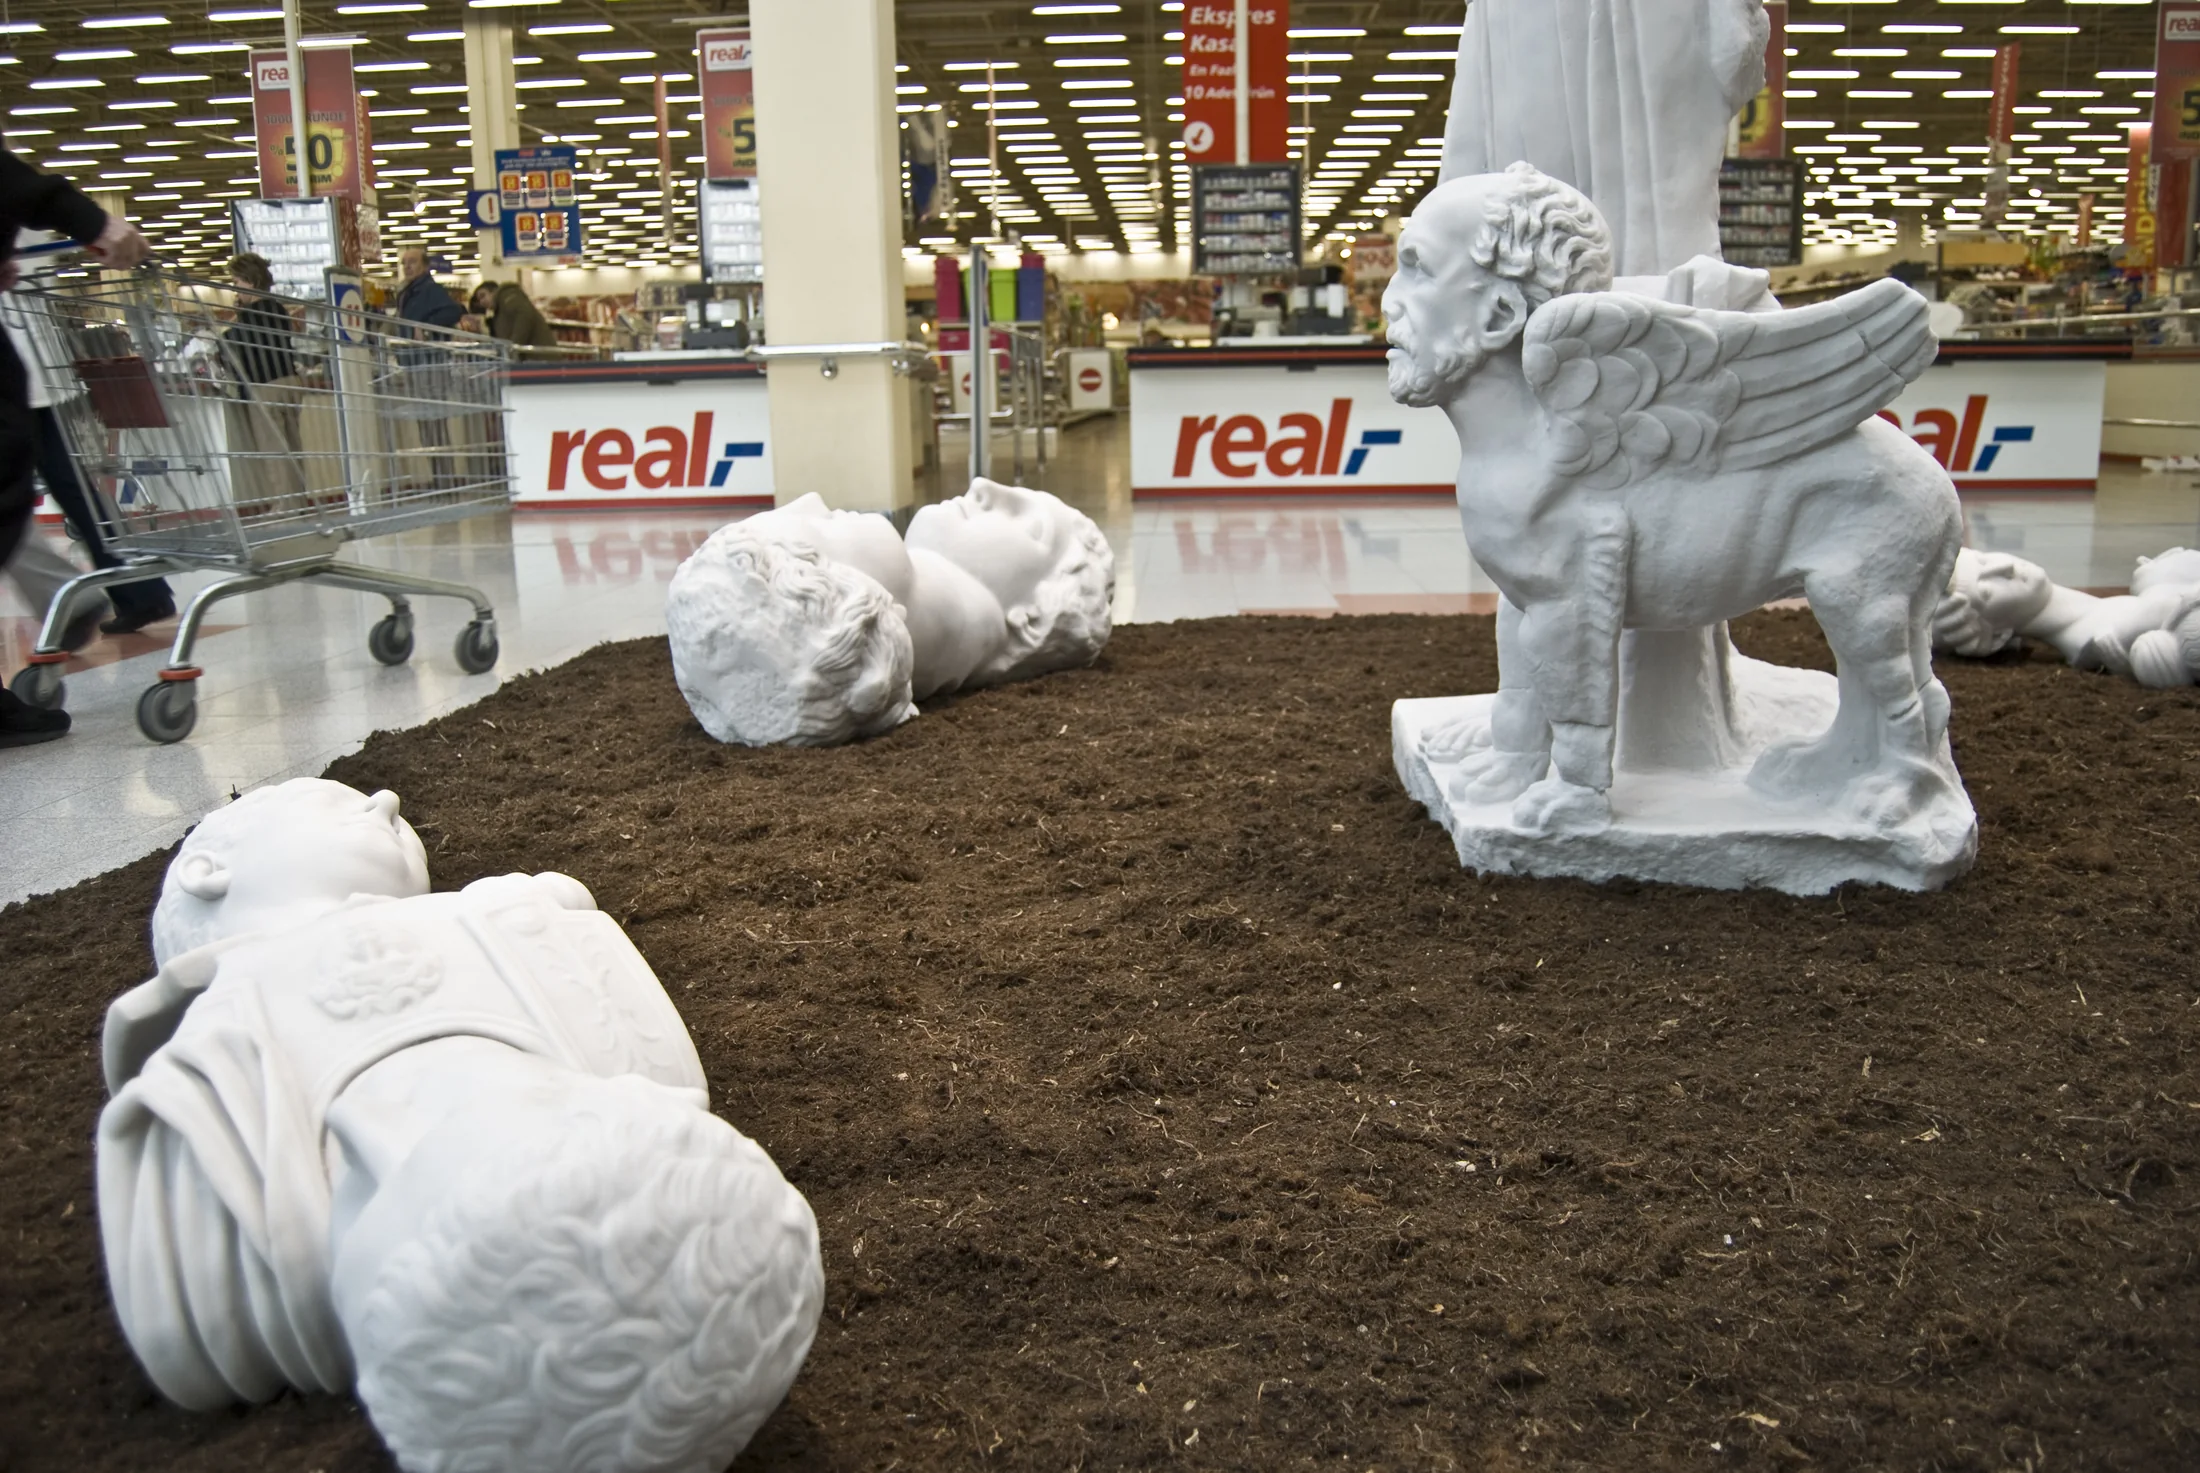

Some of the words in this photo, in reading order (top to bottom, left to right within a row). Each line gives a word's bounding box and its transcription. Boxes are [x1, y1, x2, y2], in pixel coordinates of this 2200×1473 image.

[1190, 4, 1276, 29] Ekspes
[261, 66, 289, 81] rea
[1184, 85, 1204, 100] 10
